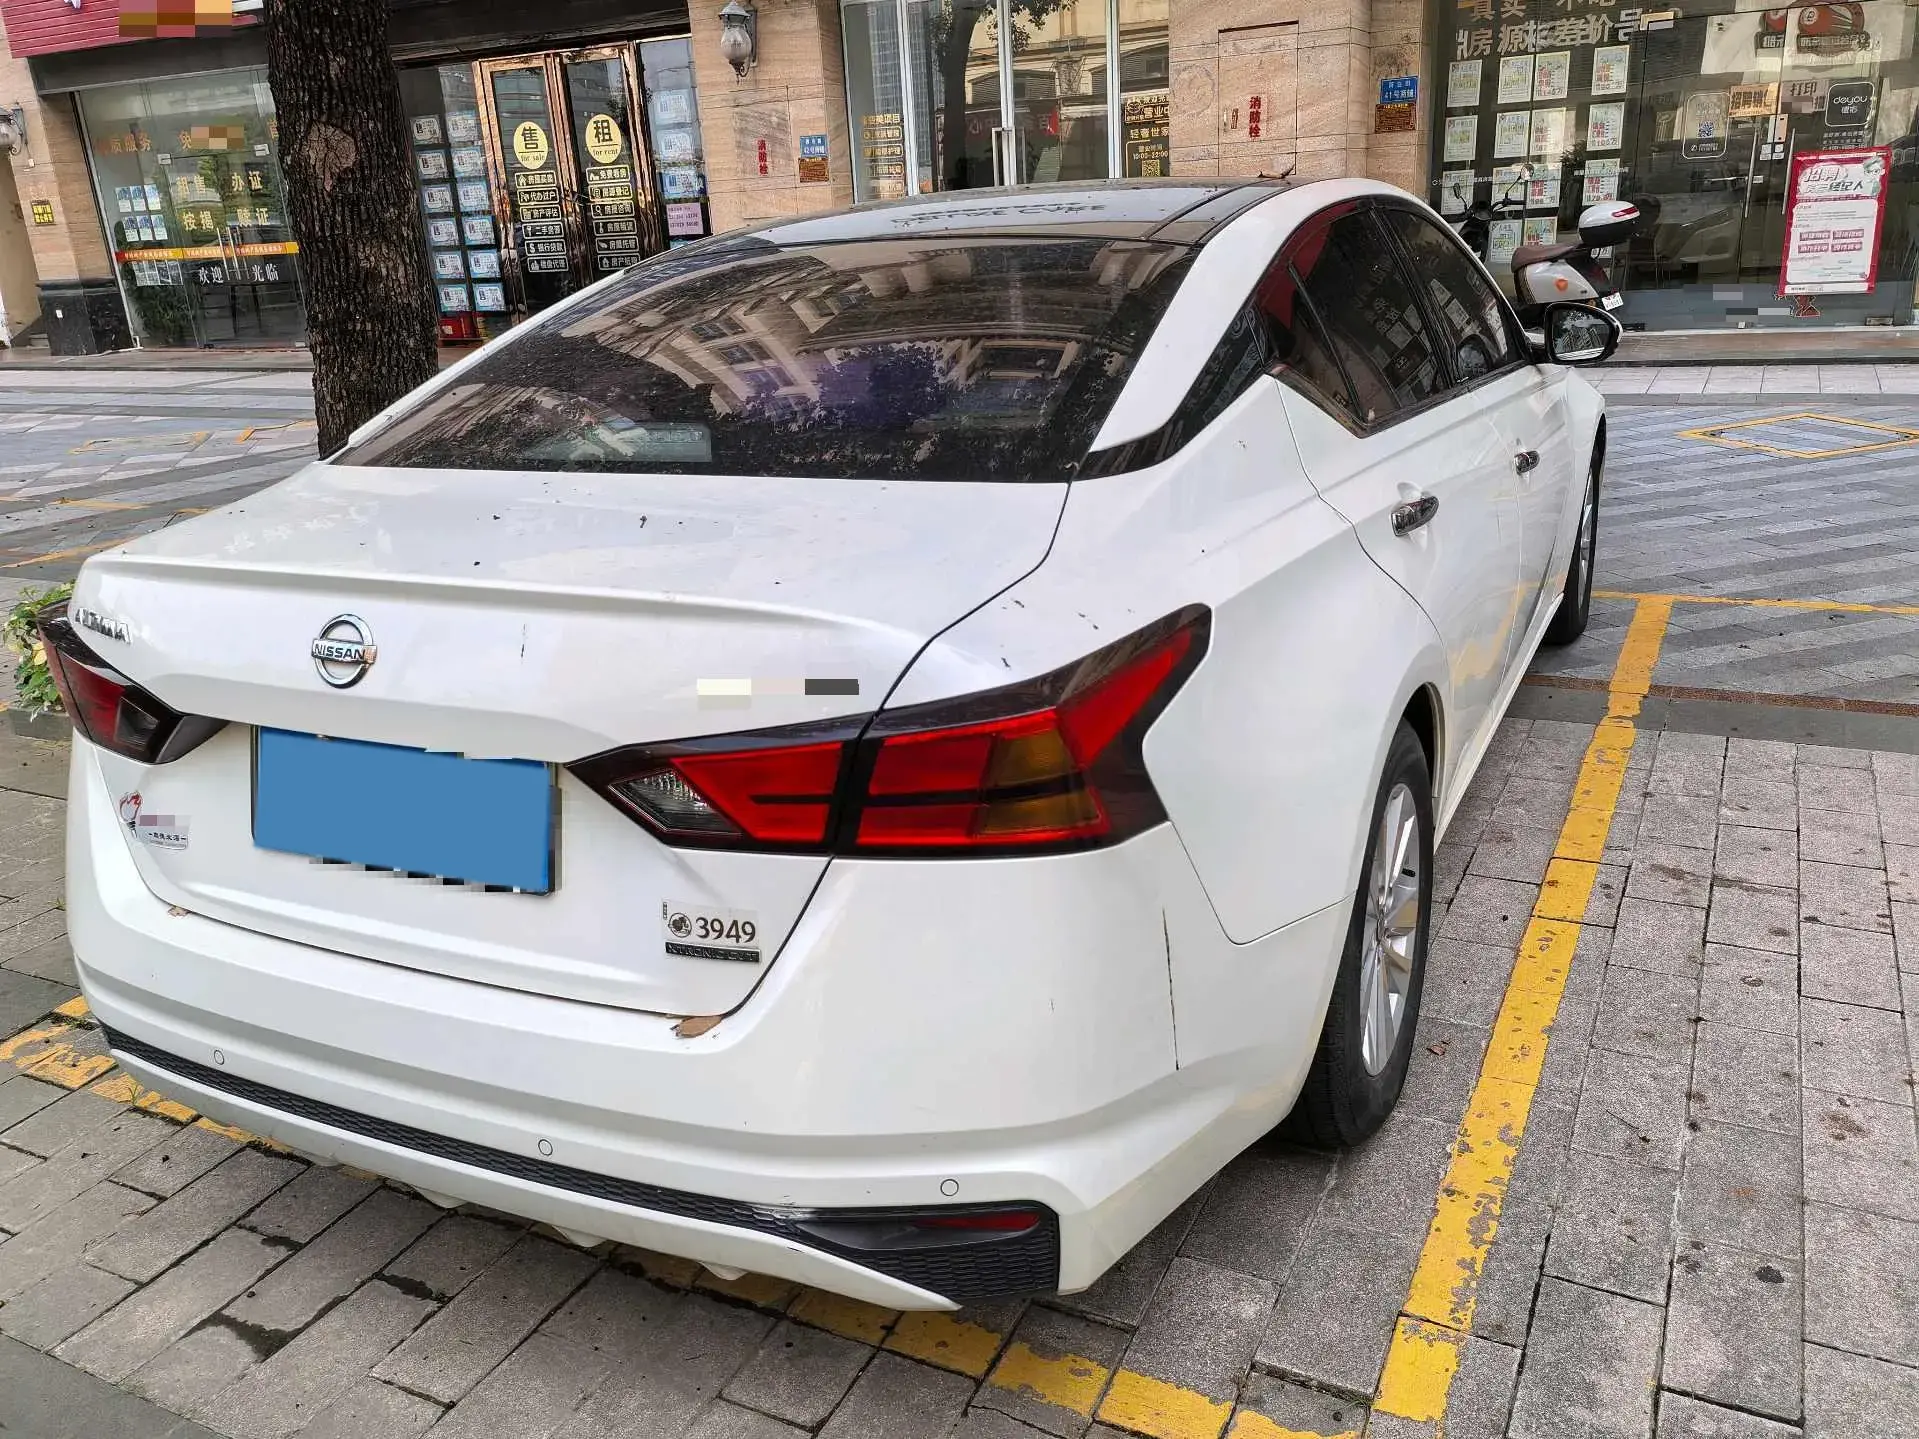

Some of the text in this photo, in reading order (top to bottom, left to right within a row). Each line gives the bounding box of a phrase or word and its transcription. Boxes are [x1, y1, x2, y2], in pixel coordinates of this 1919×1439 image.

[1790, 80, 1817, 96] 打印
[521, 126, 539, 149] 售
[592, 119, 613, 143] 租
[231, 170, 263, 193] 办证
[530, 190, 557, 202] 代办过户
[182, 209, 215, 231] 按揭
[200, 263, 280, 284] 欢迎 光临
[314, 643, 366, 660] NISSAN
[695, 916, 756, 943] 3949
